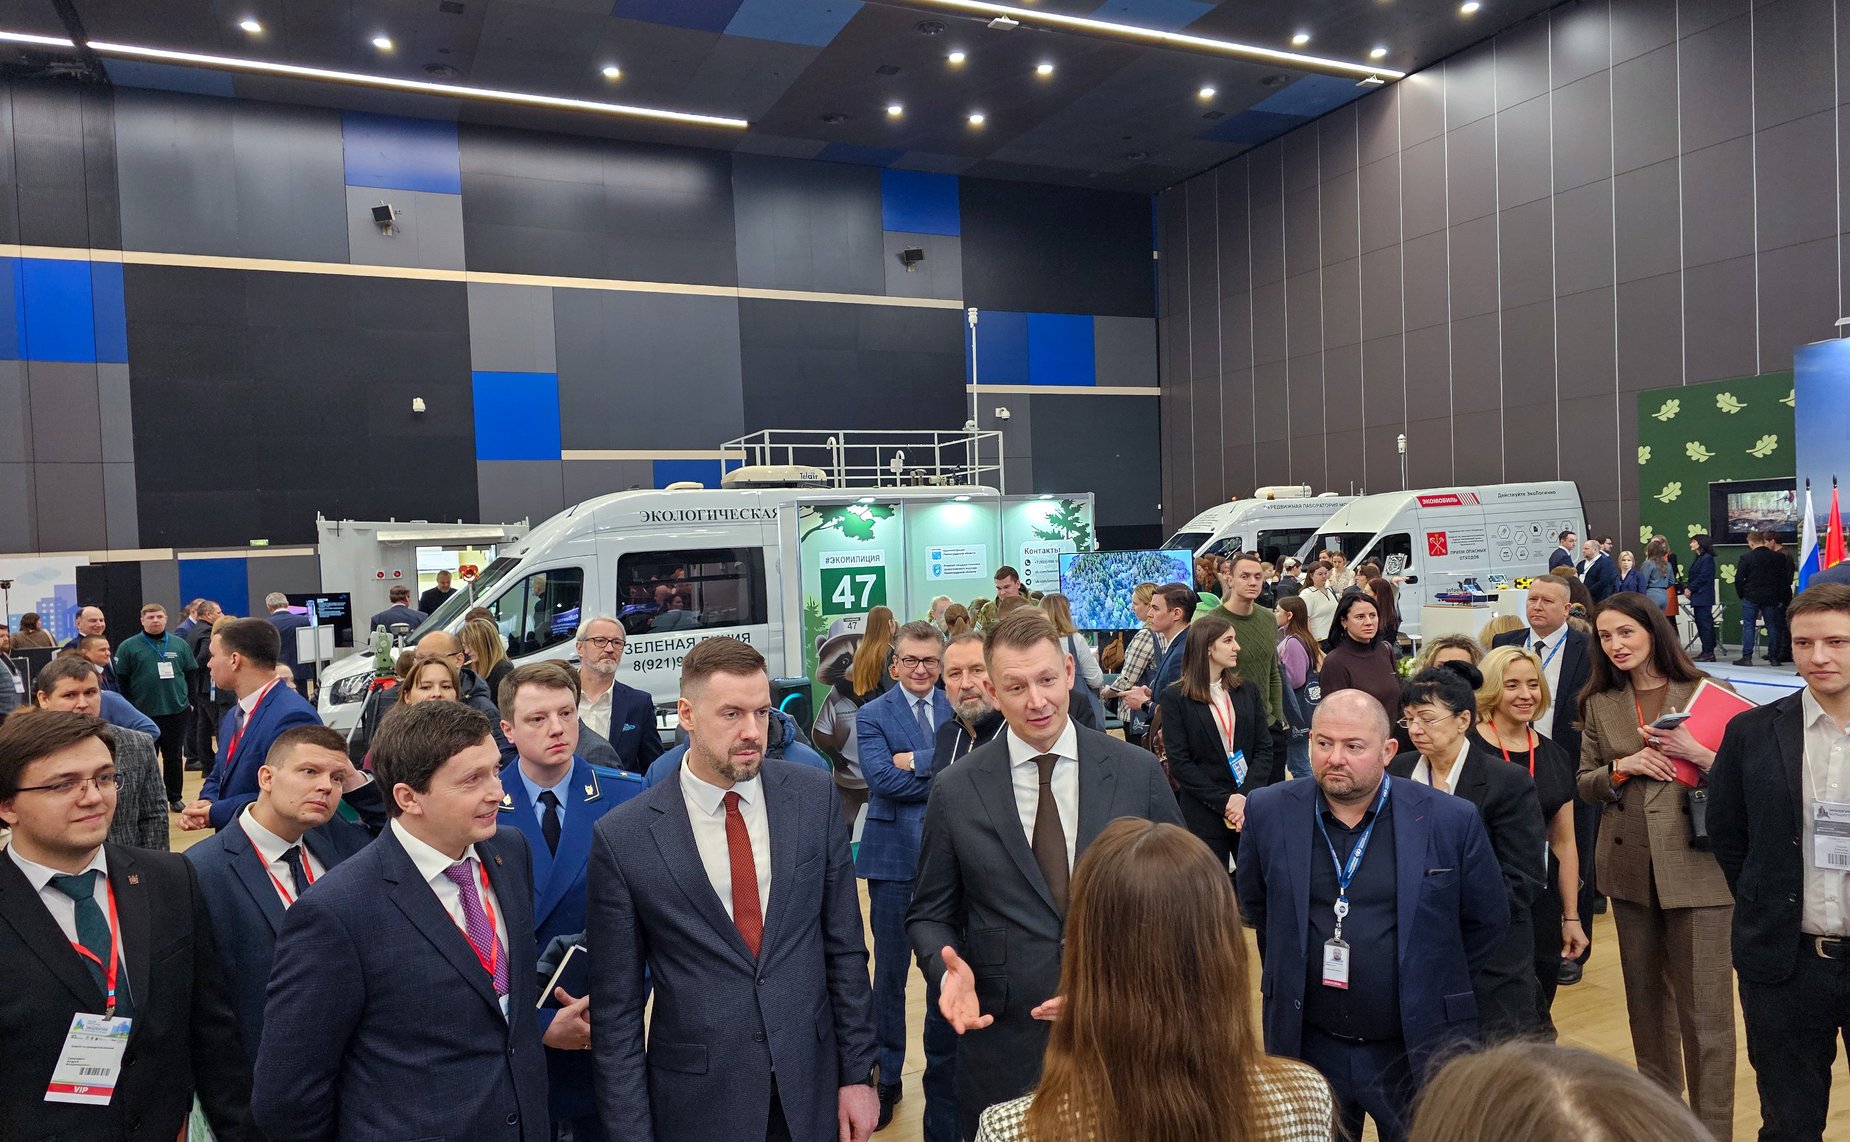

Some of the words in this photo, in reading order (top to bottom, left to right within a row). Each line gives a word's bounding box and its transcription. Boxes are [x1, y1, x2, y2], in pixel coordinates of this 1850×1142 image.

[1422, 497, 1458, 505] ЭКОМОБИЛЬ
[639, 508, 778, 523] ЭКОЛОГИЧЕСКАЯ
[1024, 547, 1061, 555] Контакты
[825, 554, 880, 564] #ЭКОМИЛИЦИЯ
[832, 574, 877, 609] 47
[847, 621, 858, 630] 47
[624, 637, 696, 655] ЗЕЛЕНАЯ
